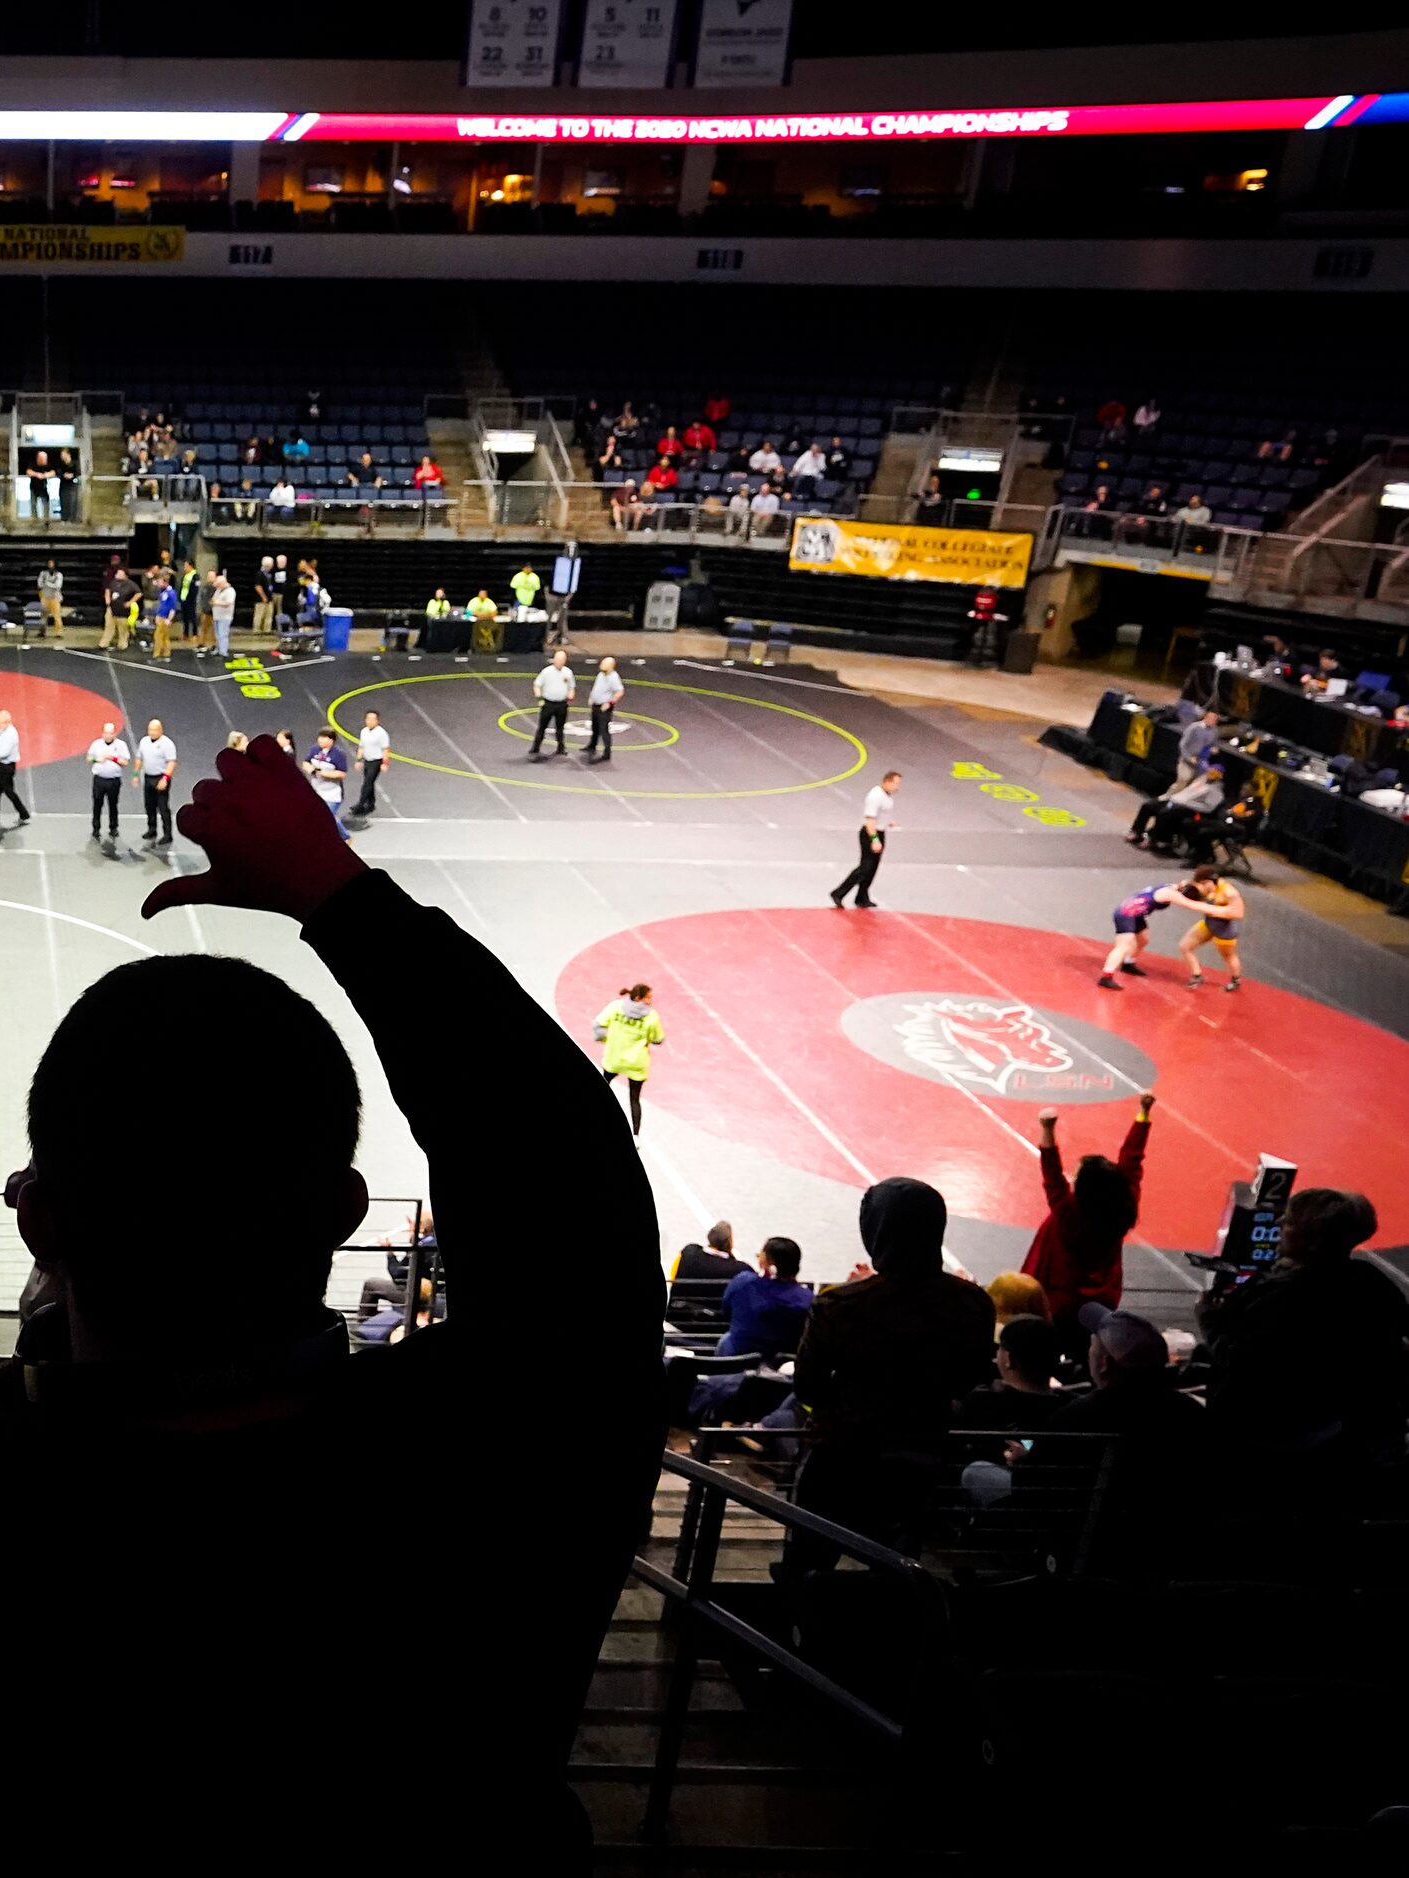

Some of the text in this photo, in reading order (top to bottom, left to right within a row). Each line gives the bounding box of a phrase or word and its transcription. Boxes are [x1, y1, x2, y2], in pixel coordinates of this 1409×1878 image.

[645, 7, 661, 22] 11
[482, 46, 502, 61] 22
[457, 110, 1069, 139] WELCOME TO THE 2020 NCWA NATIONAL CHAMPIONSHIPS
[3, 227, 91, 242] NATIONAL
[1263, 1171, 1287, 1200] 2
